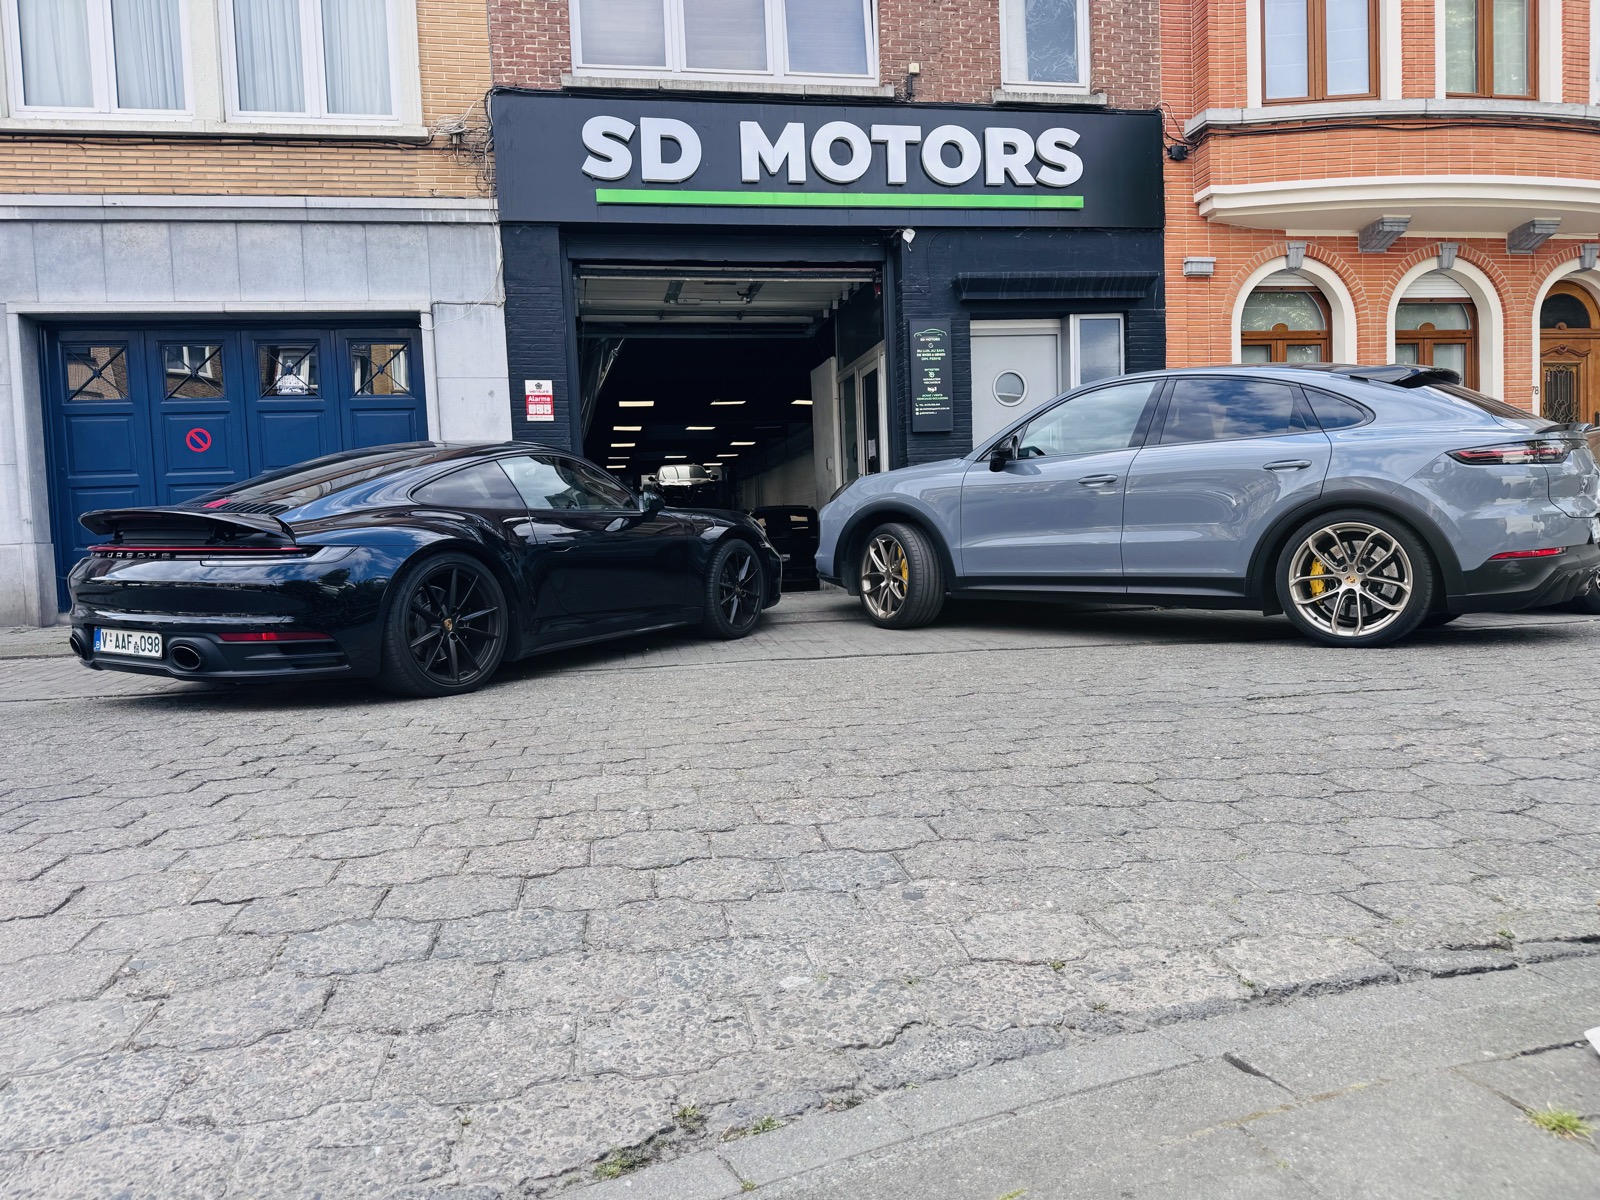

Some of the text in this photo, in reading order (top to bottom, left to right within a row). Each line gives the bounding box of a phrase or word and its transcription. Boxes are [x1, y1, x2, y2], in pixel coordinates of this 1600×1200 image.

[581, 115, 1084, 188] SD MOTORS
[1531, 385, 1539, 395] 78
